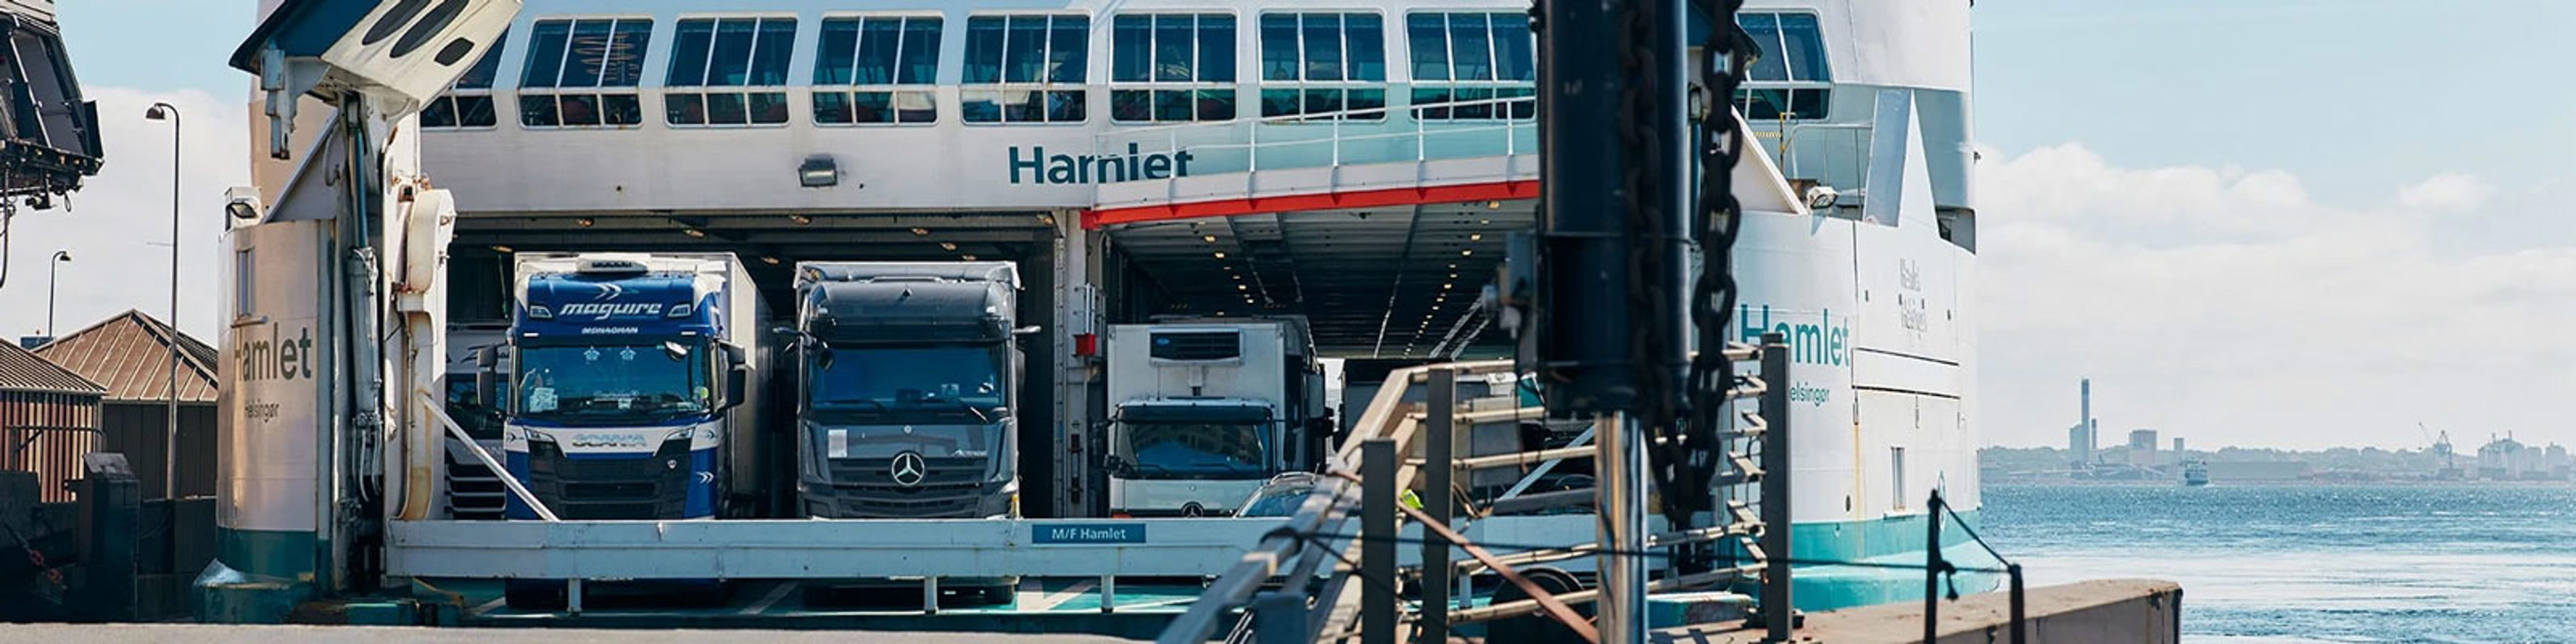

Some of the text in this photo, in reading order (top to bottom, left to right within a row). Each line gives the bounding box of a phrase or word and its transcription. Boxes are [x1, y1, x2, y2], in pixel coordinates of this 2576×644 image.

[1008, 142, 1194, 184] Hamlet
[559, 303, 662, 321] maguire
[1790, 380, 1830, 407] elsingør
[1051, 527, 1127, 540] M/F Hamlet
